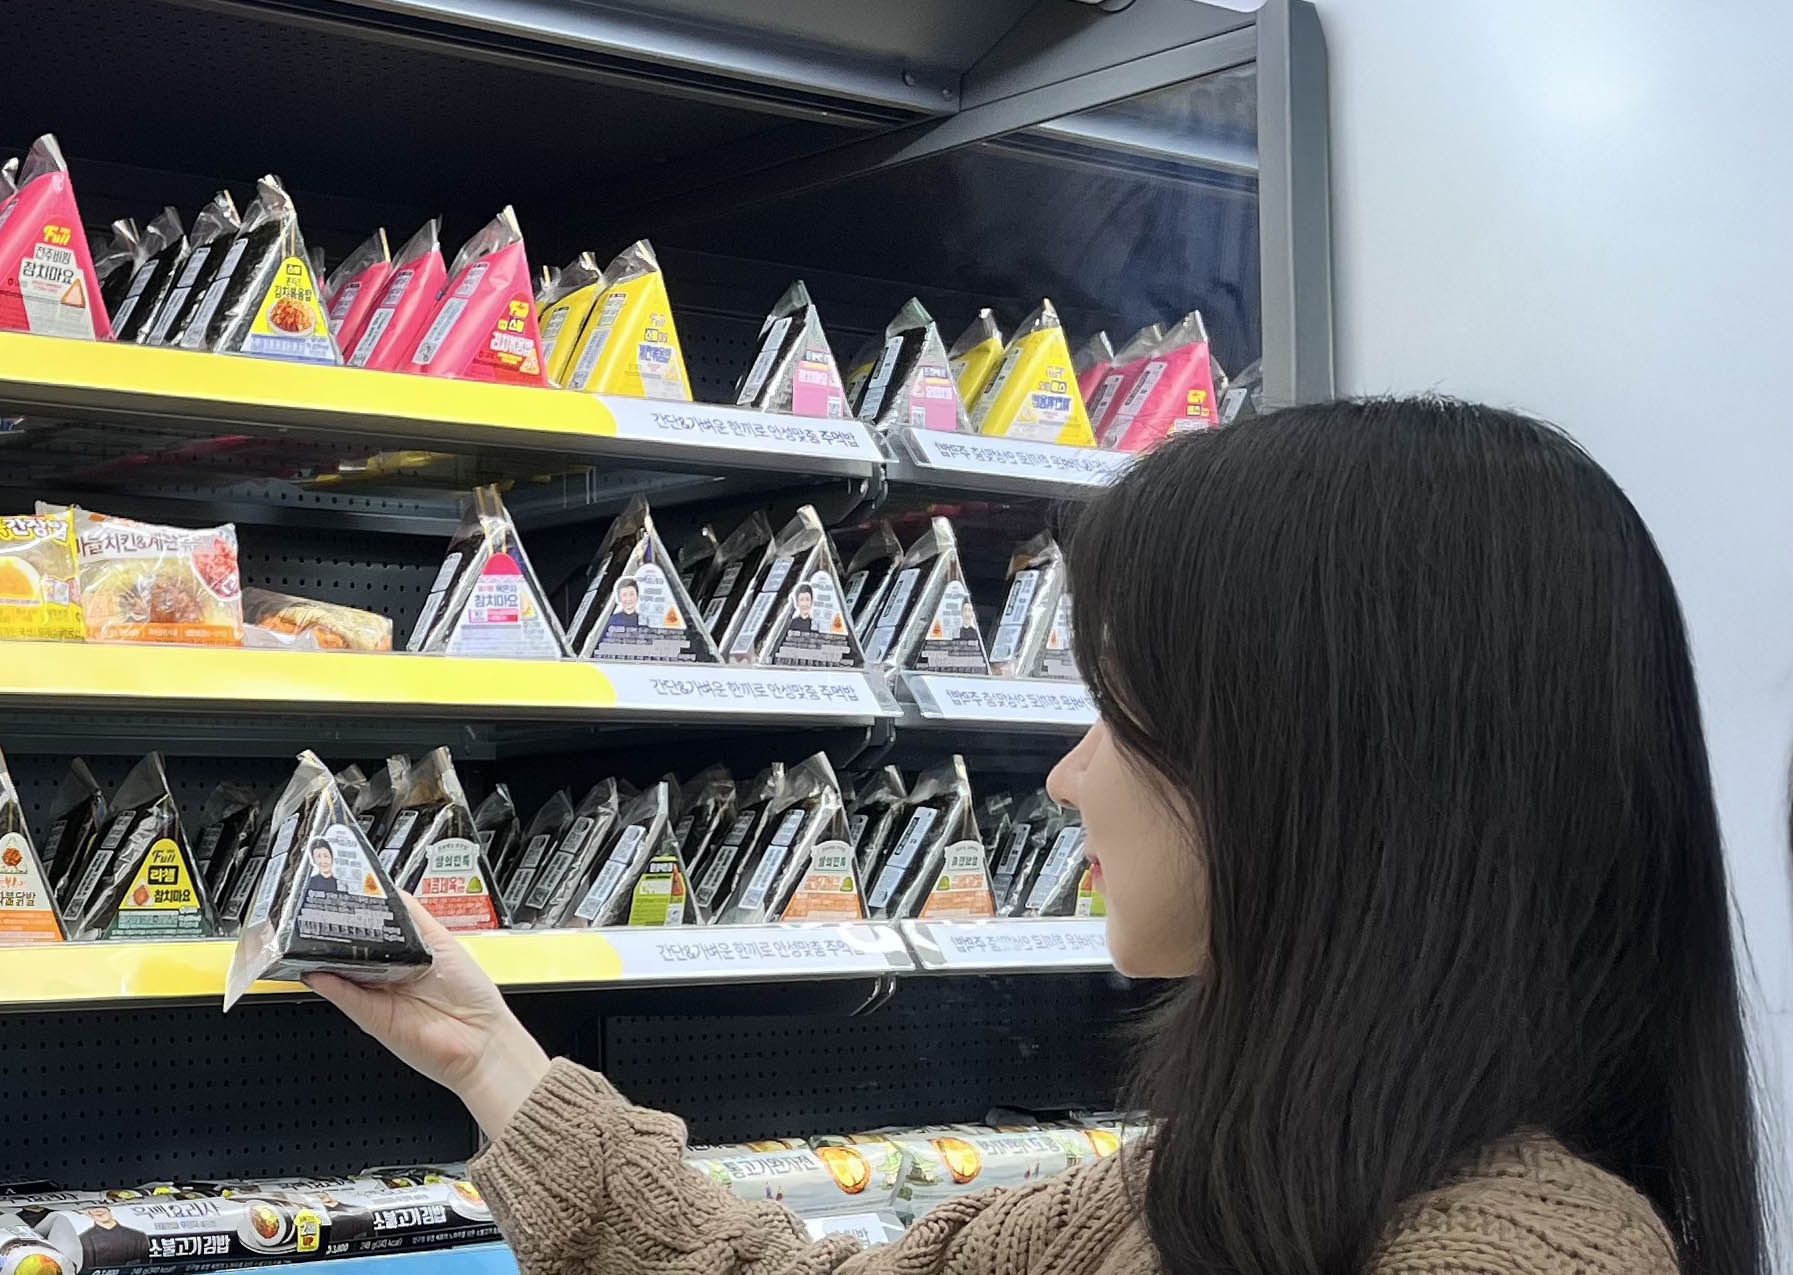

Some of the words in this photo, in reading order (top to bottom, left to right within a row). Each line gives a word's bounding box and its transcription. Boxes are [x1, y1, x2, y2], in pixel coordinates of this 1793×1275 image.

[23, 262, 74, 284] 참치마요
[154, 889, 191, 902] 참치마요
[373, 1205, 448, 1231] 소불고기김밥
[149, 1236, 230, 1258] 소불고기김밥
